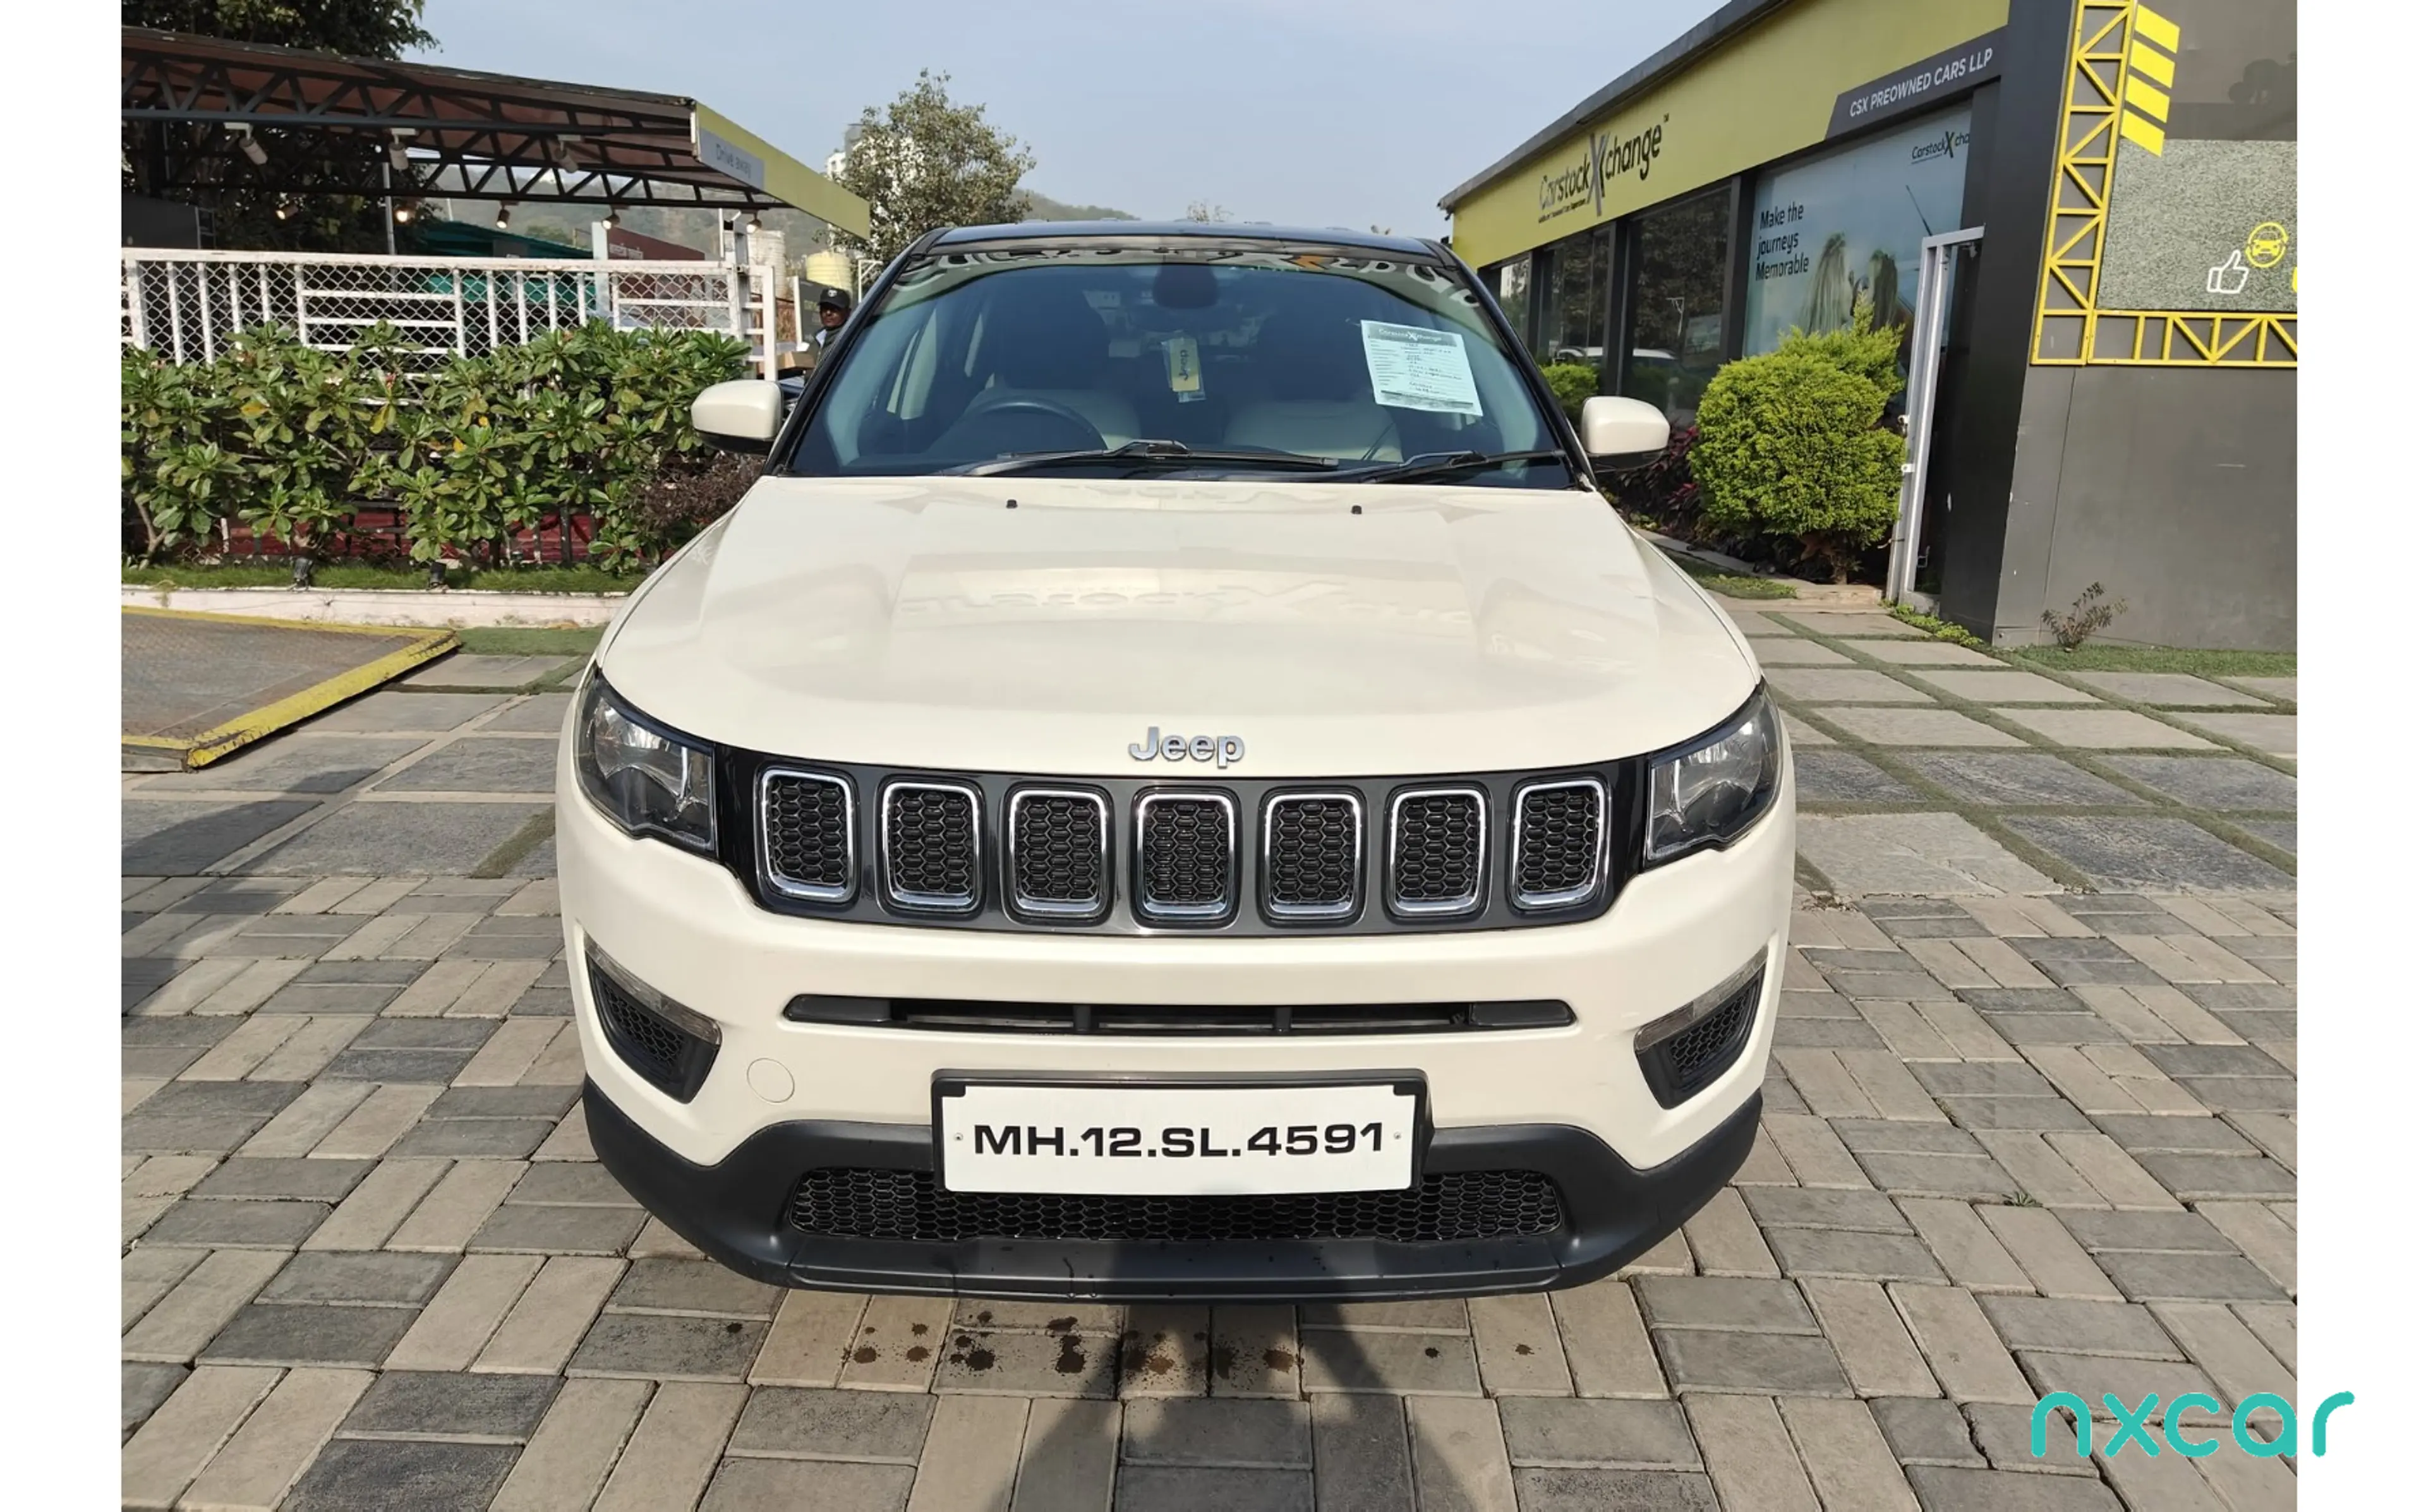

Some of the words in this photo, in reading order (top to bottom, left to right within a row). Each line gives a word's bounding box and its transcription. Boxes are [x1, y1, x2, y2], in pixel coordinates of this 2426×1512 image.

[1849, 97, 1870, 117] CSX
[1870, 72, 1931, 111] PREOWNED
[1933, 59, 1966, 86] CARS
[1969, 47, 1993, 73] LLP
[1759, 206, 1785, 231] Make
[1787, 201, 1804, 223] the
[1756, 232, 1799, 260] journeys
[1756, 252, 1809, 281] Memorable
[1128, 726, 1245, 769] Jeep
[974, 1122, 1383, 1158] MH.12.SL.4591
